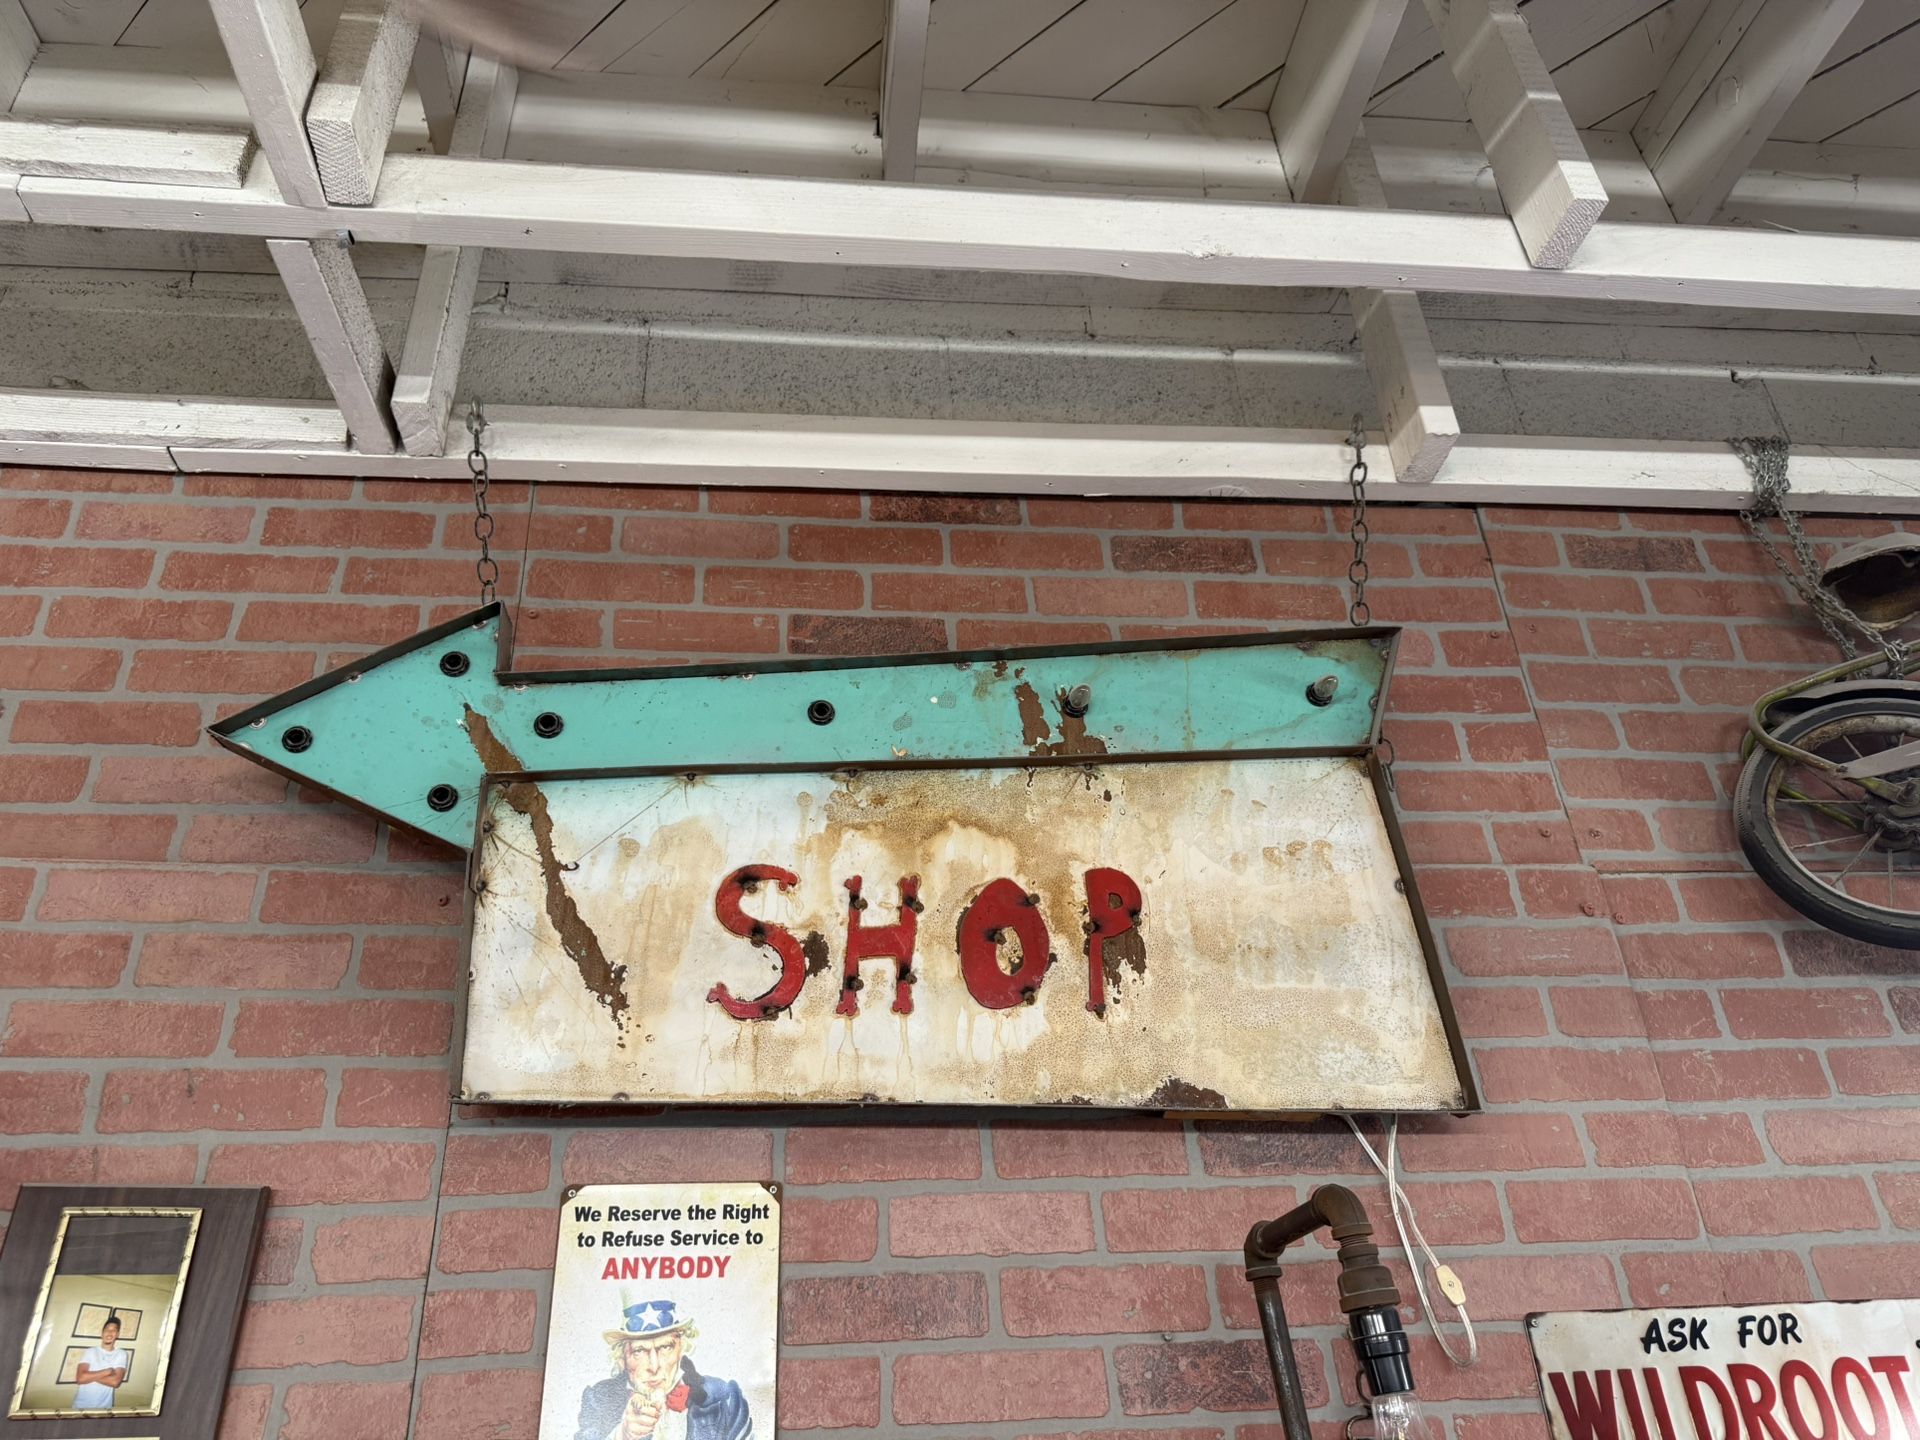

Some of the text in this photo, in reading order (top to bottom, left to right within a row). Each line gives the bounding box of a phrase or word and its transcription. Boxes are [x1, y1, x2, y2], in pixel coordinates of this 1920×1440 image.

[706, 864, 1143, 1020] SHOP
[574, 1203, 770, 1224] We Reserve the Right
[577, 1229, 764, 1247] to Refuse Service to
[601, 1255, 732, 1280] ANYBODY
[1640, 1312, 1803, 1354] ASK FOR
